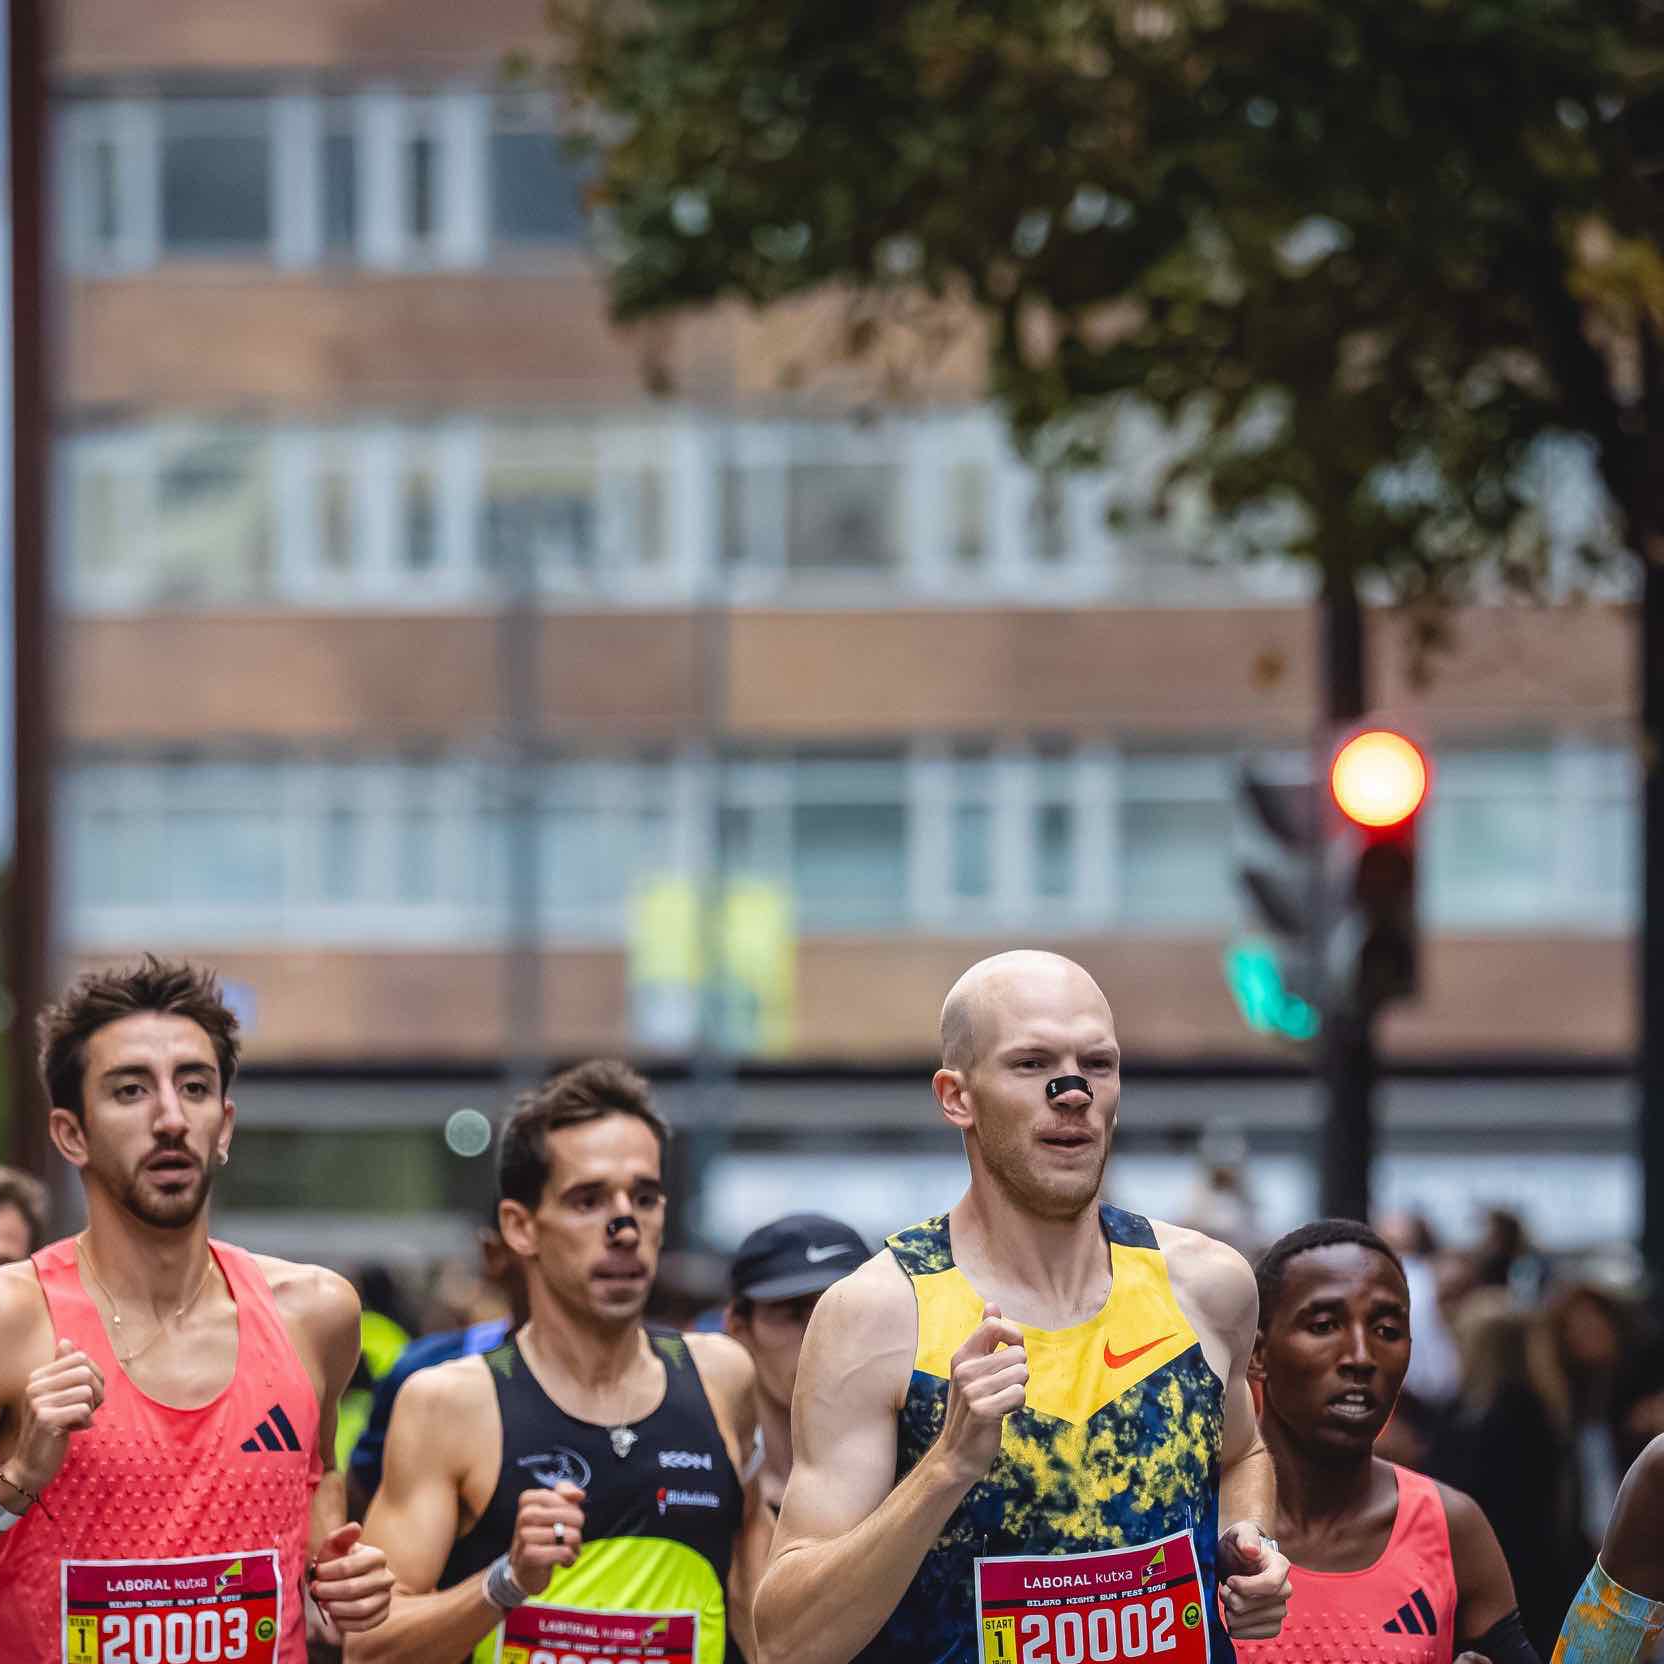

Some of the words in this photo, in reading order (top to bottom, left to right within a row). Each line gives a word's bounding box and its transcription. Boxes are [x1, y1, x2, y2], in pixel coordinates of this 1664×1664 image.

[106, 1579, 171, 1592] LABORAL
[174, 1577, 208, 1590] kutxa
[1024, 1576, 1092, 1589] LABORAL
[1095, 1570, 1133, 1584] kutxa
[1067, 1596, 1095, 1605] NIGHT
[1122, 1589, 1143, 1598] FEST
[985, 1619, 1013, 1629] START
[78, 1628, 86, 1653] 1
[994, 1630, 1004, 1657] 1
